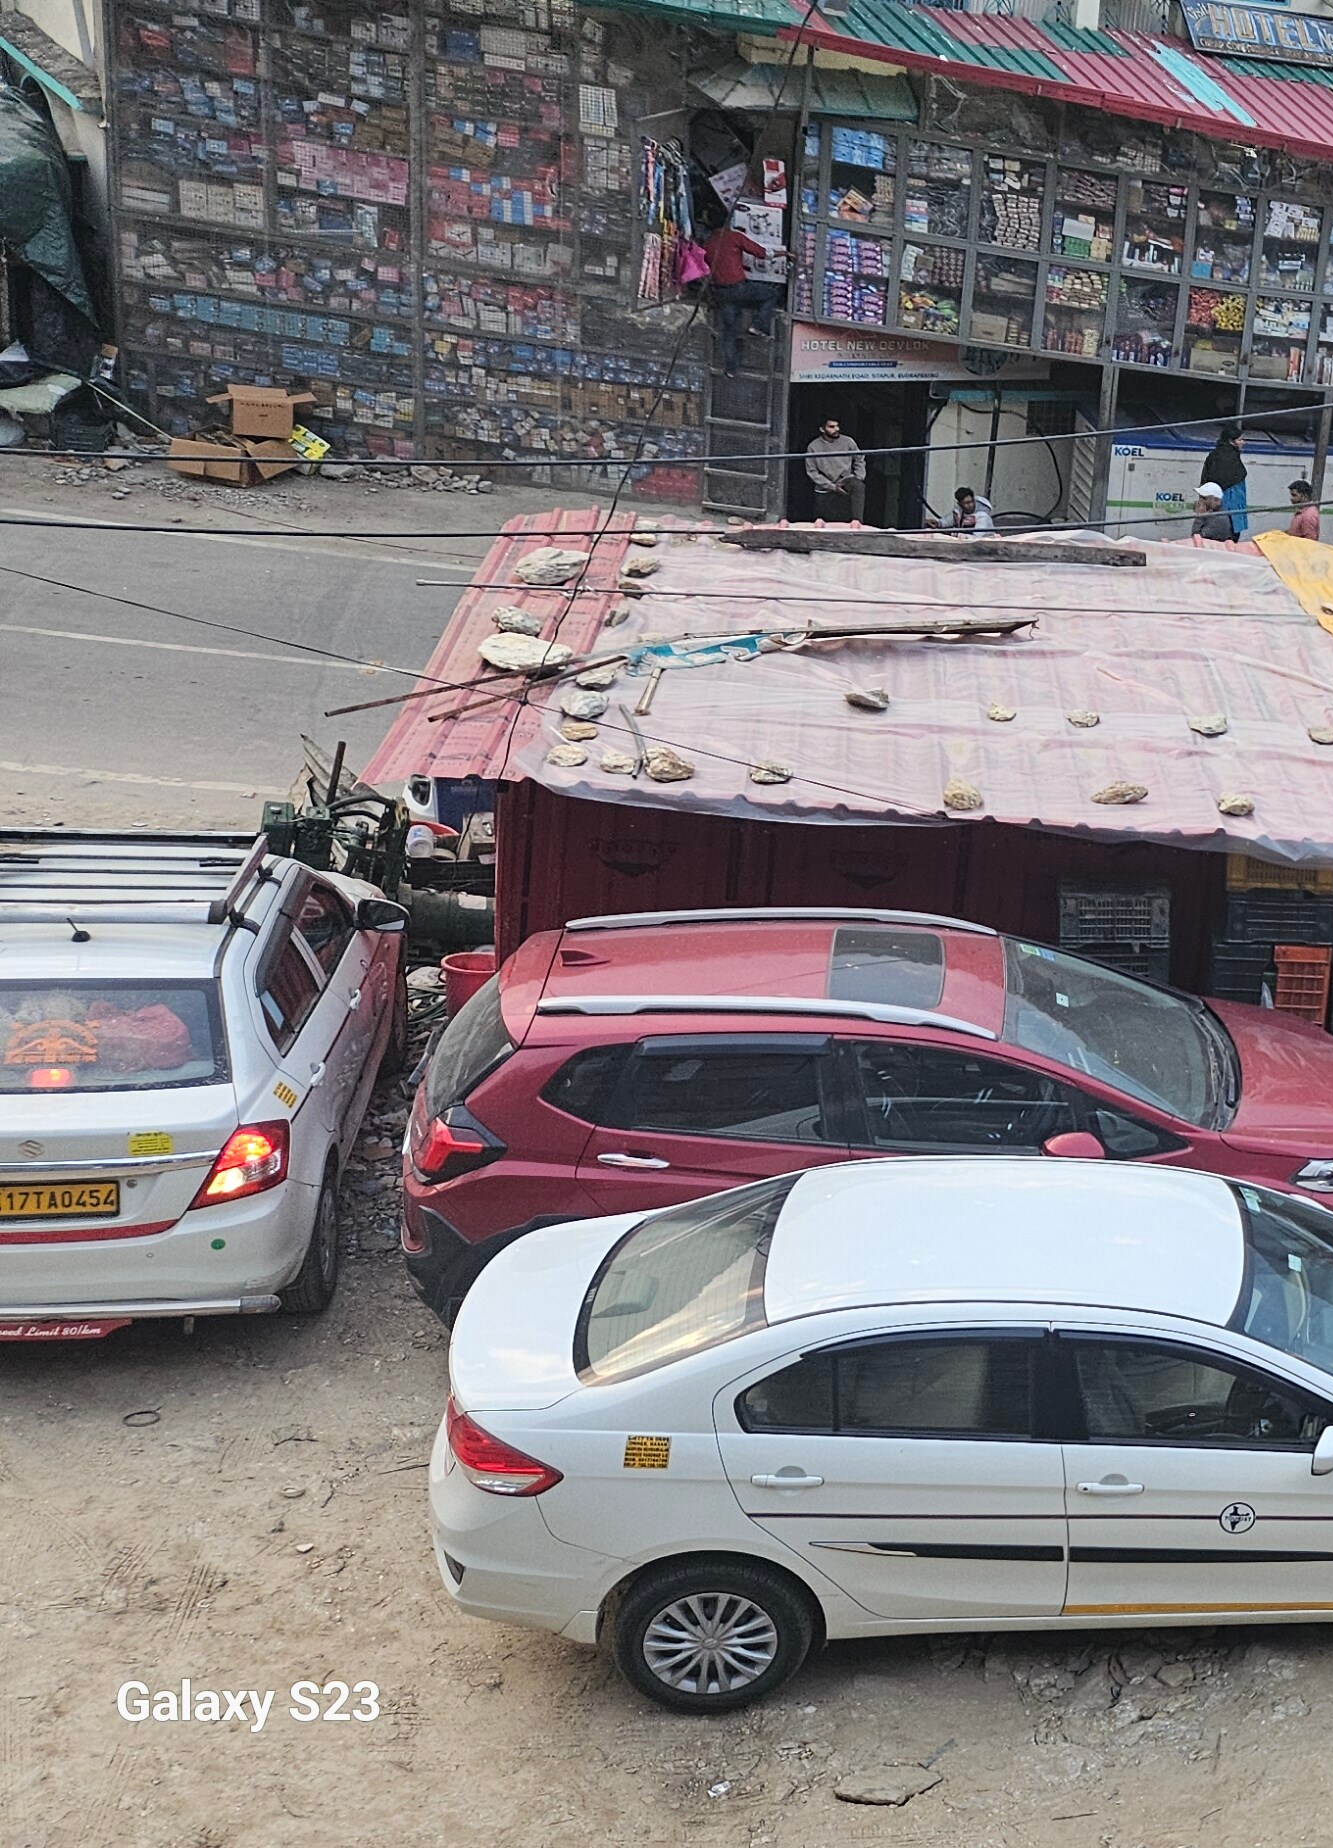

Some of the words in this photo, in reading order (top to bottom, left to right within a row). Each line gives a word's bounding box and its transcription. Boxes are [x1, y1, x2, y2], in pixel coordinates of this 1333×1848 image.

[1209, 4, 1318, 51] HOTEL
[801, 340, 844, 351] HOTEL
[846, 340, 876, 351] NEW
[1115, 447, 1144, 457] KOEL
[1155, 492, 1185, 502] KOEL
[25, 1325, 59, 1338] Limit
[61, 1324, 102, 1337] 80/km
